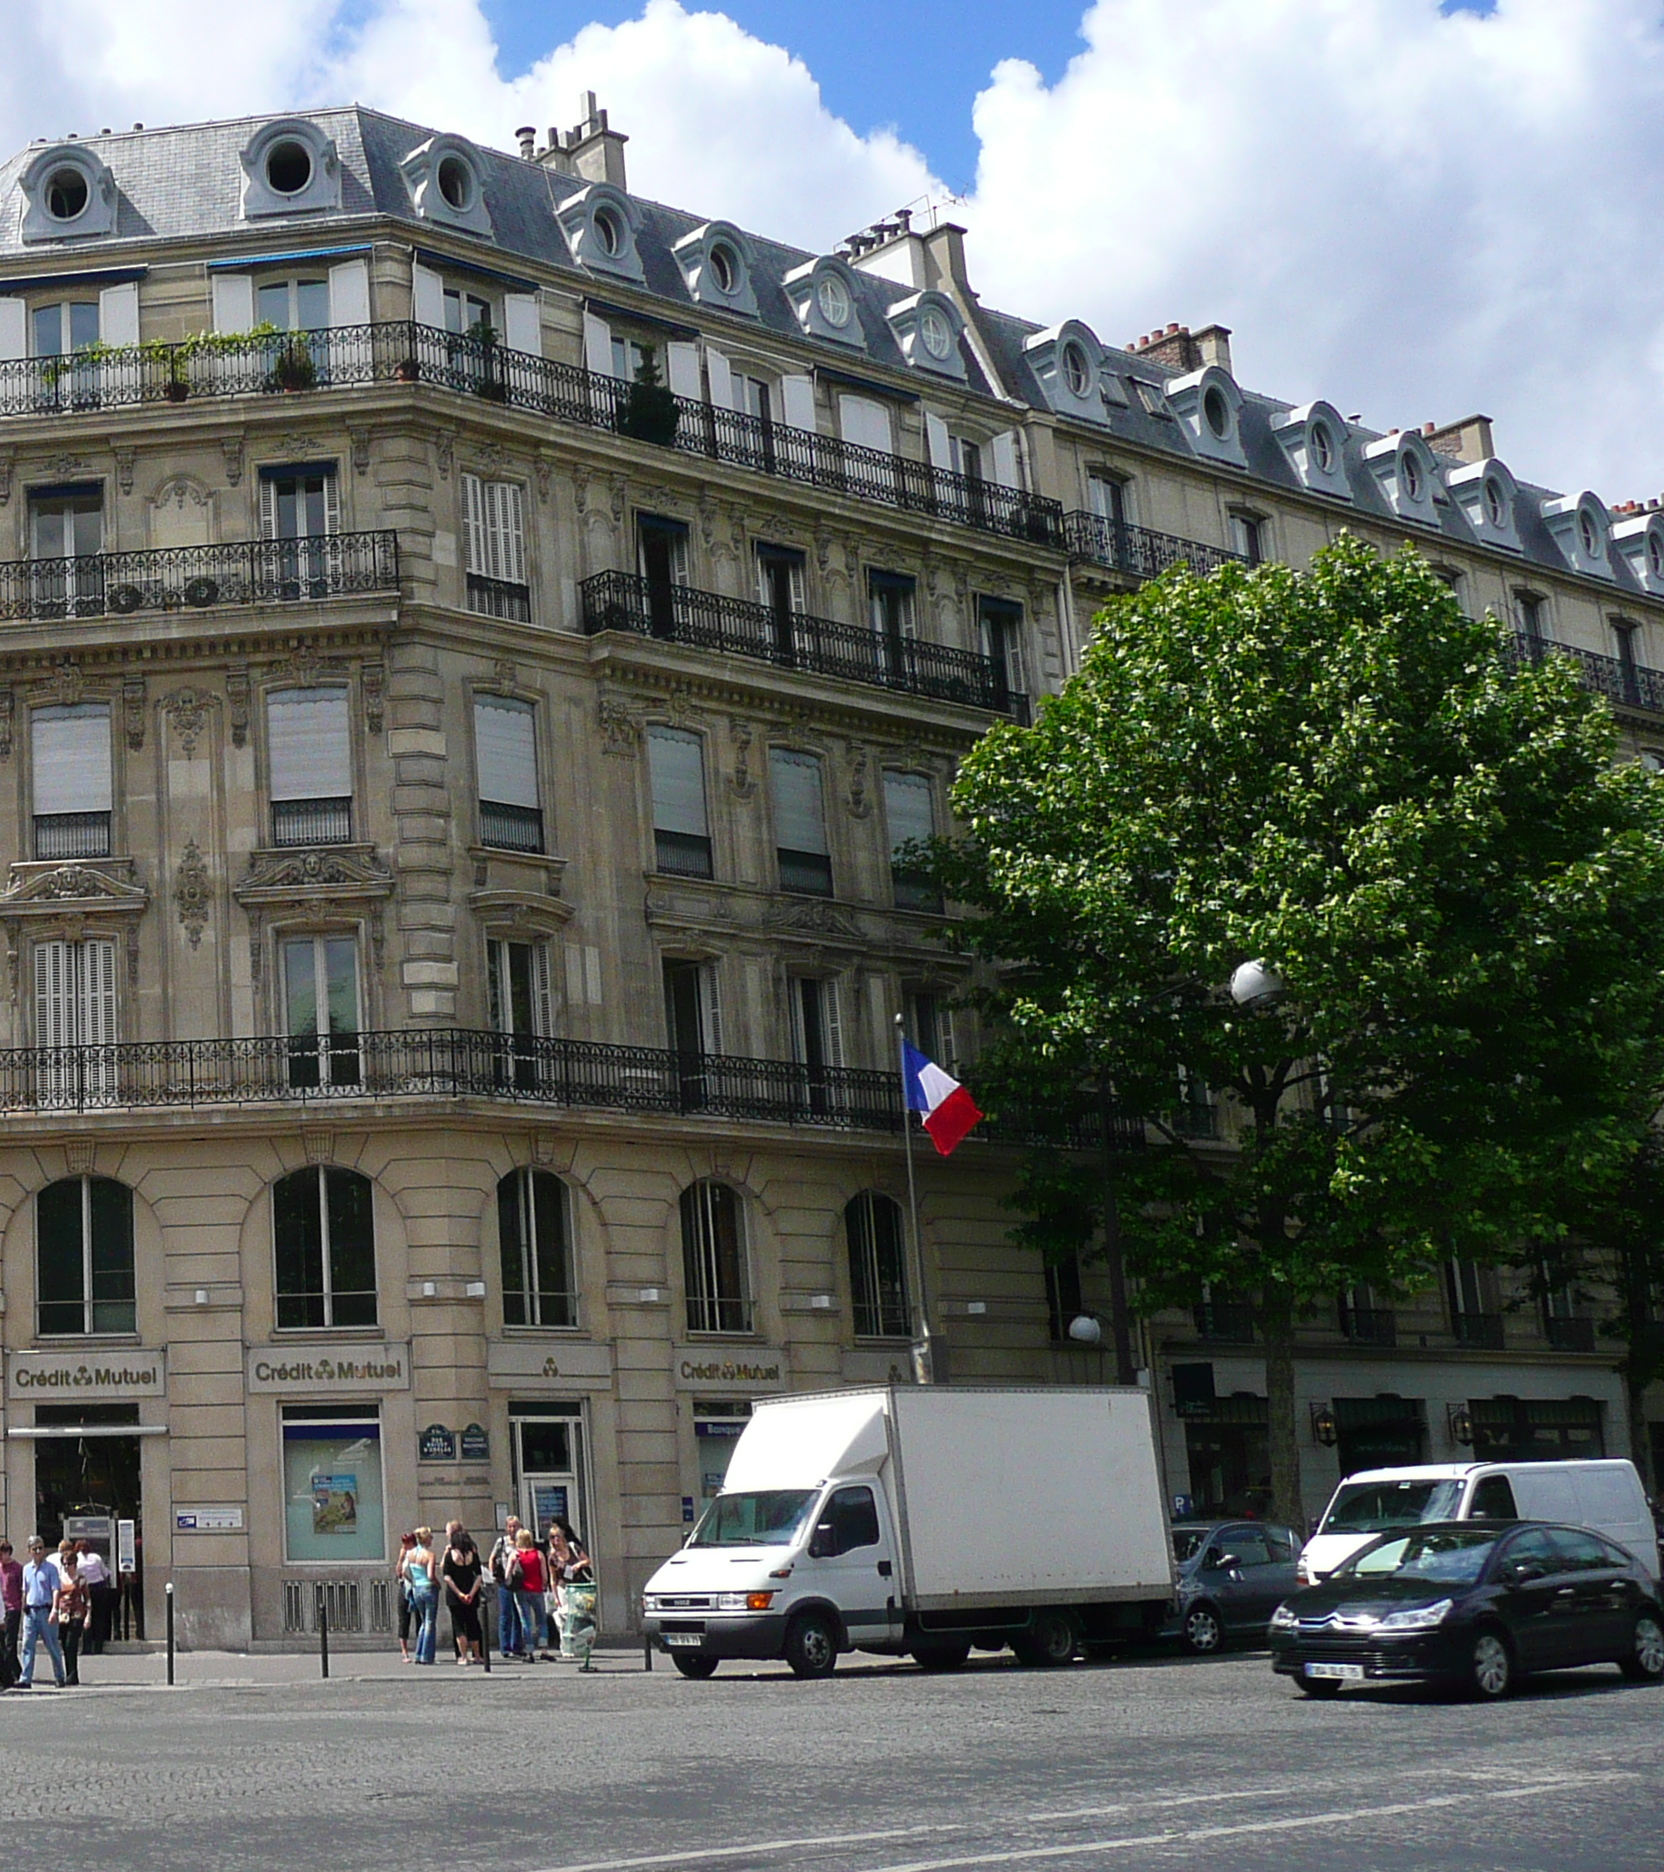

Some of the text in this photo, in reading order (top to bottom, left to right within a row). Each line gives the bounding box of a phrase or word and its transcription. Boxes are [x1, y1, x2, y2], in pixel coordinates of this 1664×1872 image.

[15, 1366, 157, 1387] Crédit Mutuel
[255, 1360, 402, 1381] Crédit Mutuel
[680, 1360, 780, 1380] Crédit Mutuel
[707, 1424, 741, 1435] Banque
